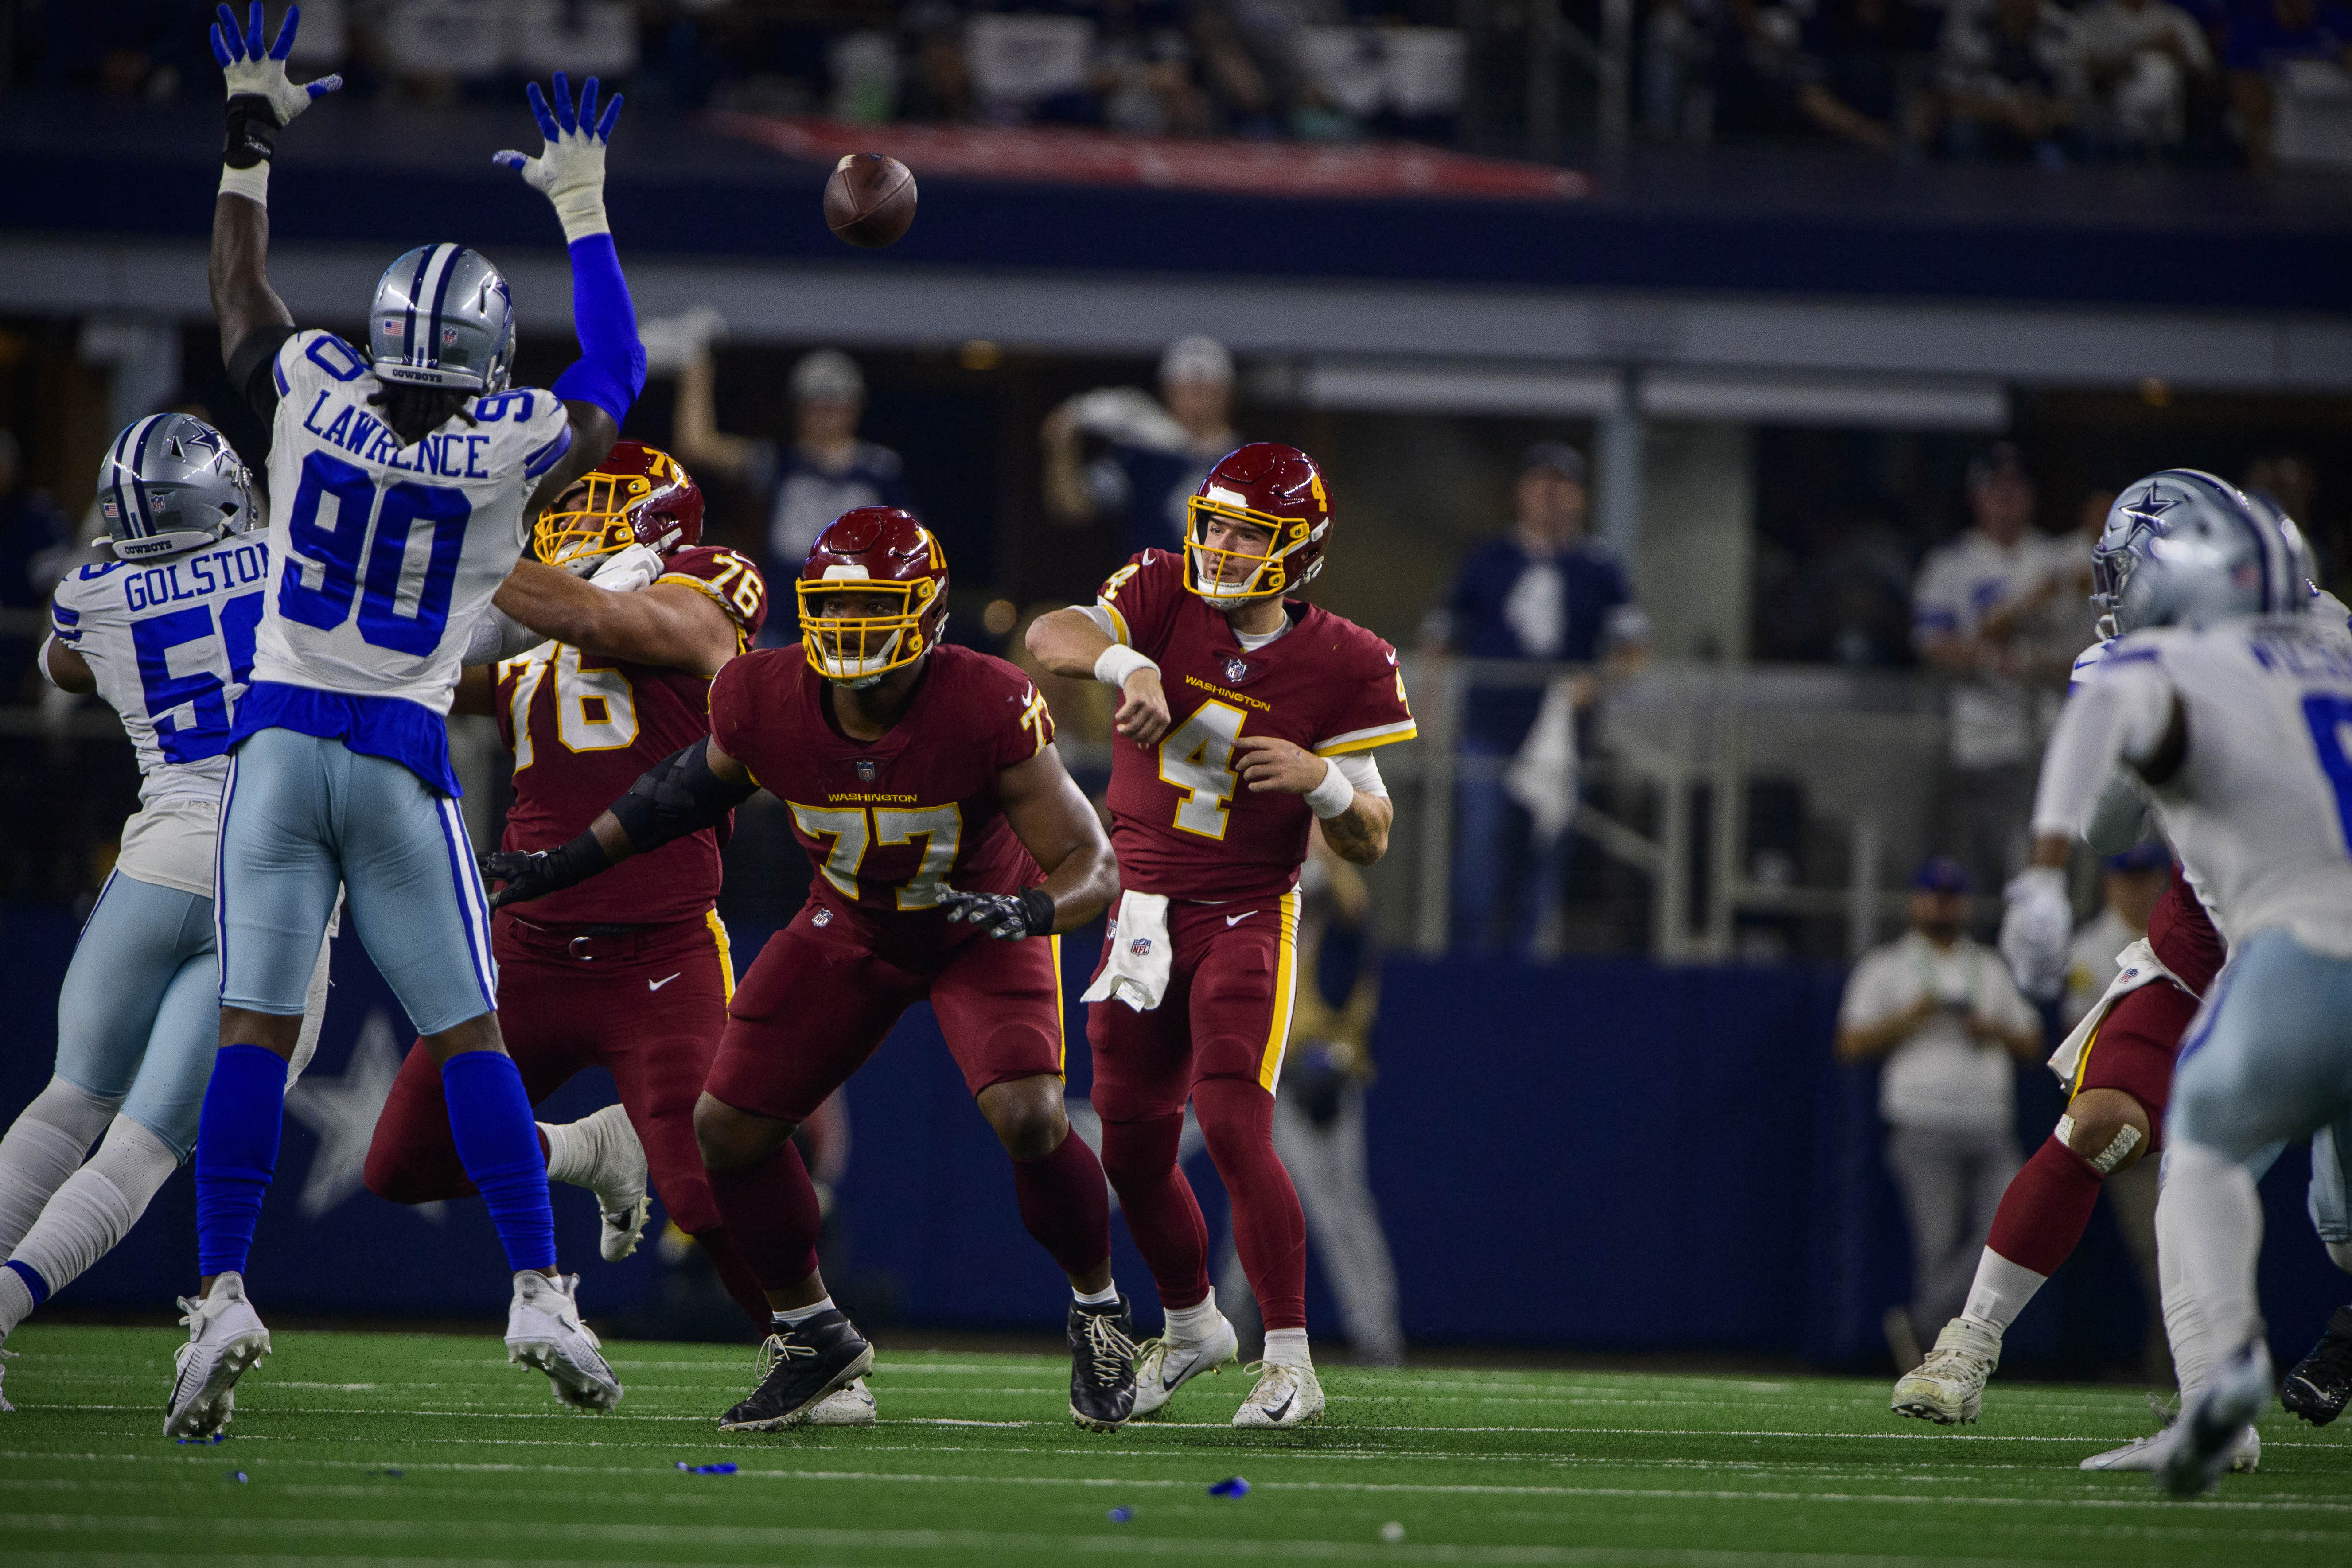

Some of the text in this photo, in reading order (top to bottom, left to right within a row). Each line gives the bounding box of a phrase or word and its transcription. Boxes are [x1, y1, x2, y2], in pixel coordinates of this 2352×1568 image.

[392, 368, 443, 383] COWBOYS
[642, 447, 689, 489] 76
[152, 501, 164, 510] NFL
[1311, 471, 1328, 512] 4
[124, 540, 172, 554] COWBOYS
[278, 449, 472, 658] 90
[705, 553, 764, 619] 76
[1103, 562, 1141, 600] 4
[1229, 667, 1241, 678] NFL
[497, 638, 640, 777] 76
[1184, 674, 1271, 712] WASHINGTON
[1159, 698, 1248, 841] 4
[827, 793, 918, 802] WASHINGTON
[785, 802, 963, 911] 77
[1133, 945, 1147, 954] NFL
